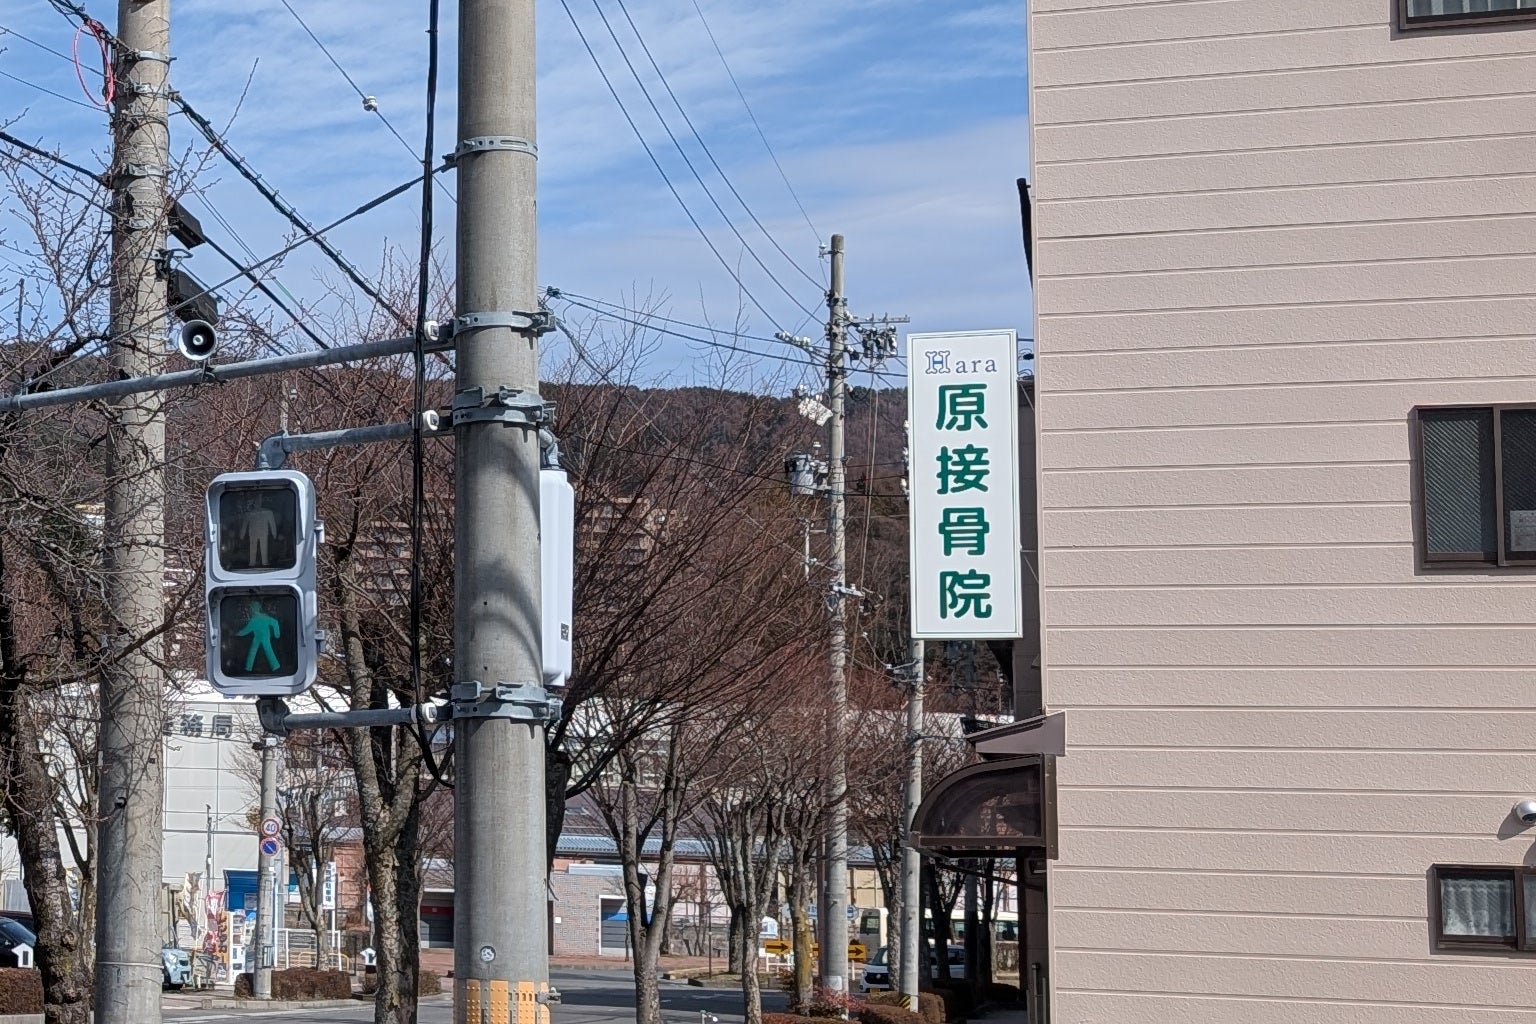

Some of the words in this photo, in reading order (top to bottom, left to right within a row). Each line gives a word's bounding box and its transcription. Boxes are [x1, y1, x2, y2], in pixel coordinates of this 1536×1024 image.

[925, 350, 997, 375] Hara
[936, 383, 992, 619] 原接骨院
[266, 823, 276, 832] 40
